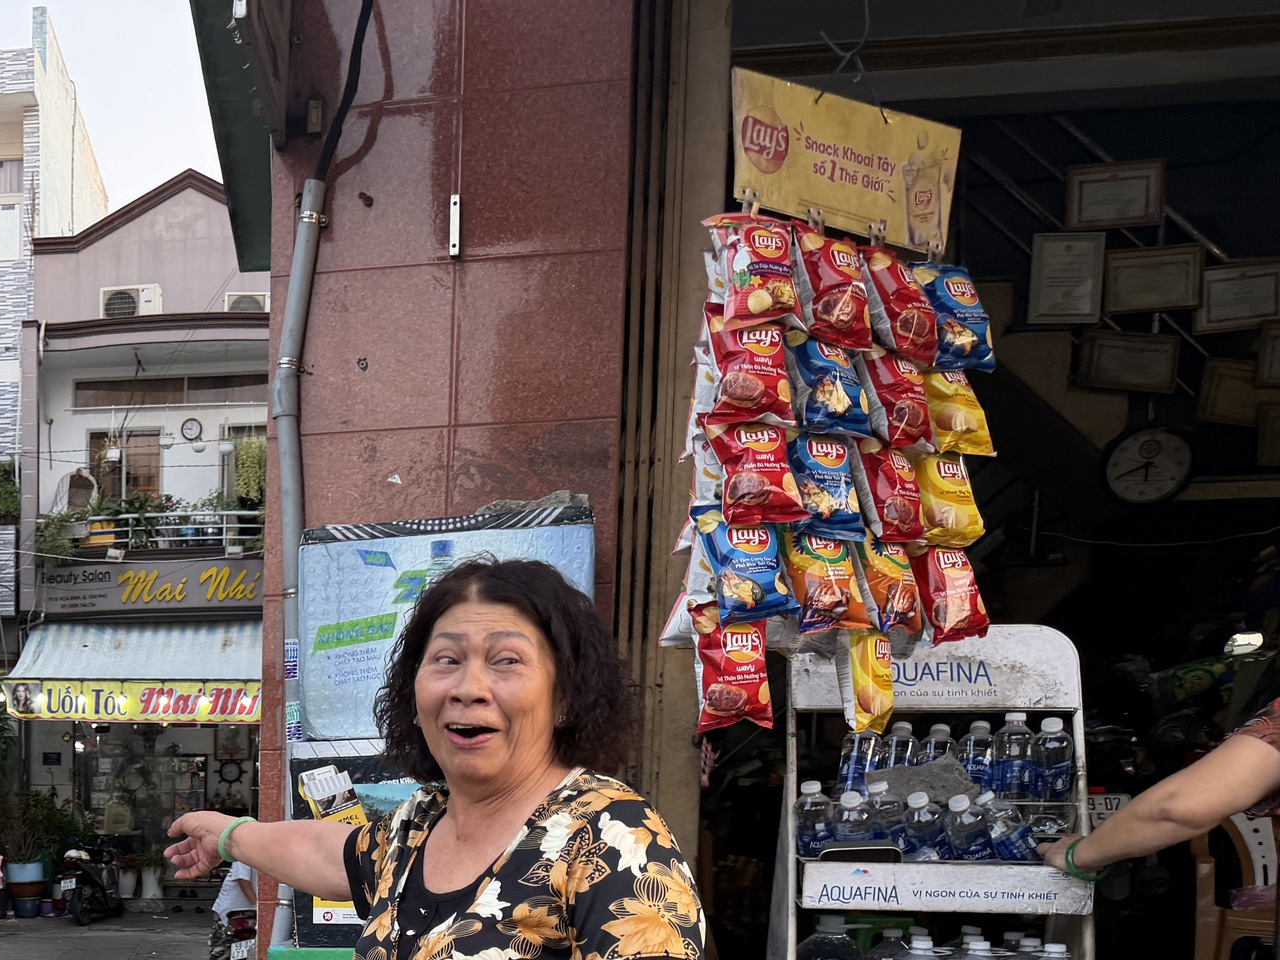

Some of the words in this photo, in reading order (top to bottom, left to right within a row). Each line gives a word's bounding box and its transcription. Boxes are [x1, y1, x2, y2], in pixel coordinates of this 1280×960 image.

[744, 117, 787, 160] Lay's
[805, 136, 839, 158] Snack
[842, 145, 874, 168] Khoai
[877, 156, 896, 176] Tây
[813, 160, 827, 176] số
[827, 159, 837, 182] 1
[839, 167, 858, 185] Thế
[754, 235, 782, 251] Lay's
[834, 249, 859, 269] Lay's
[949, 279, 974, 298] Lay's
[742, 328, 781, 347] Lay's
[741, 428, 777, 443] Lay's
[811, 440, 843, 459] Lay's
[732, 527, 767, 550] Lay's
[938, 551, 966, 569] Lay's
[42, 571, 79, 584] Beauty
[82, 570, 111, 582] Salon
[117, 569, 187, 604] Mai
[199, 566, 260, 602] Nhí
[726, 631, 760, 653] Lay's
[736, 663, 755, 672] wavy
[46, 686, 86, 715] Uốn
[91, 688, 128, 716] Tóc
[139, 687, 205, 716] Mai
[208, 687, 261, 716] Nhí
[909, 688, 929, 697] của
[932, 690, 944, 698] sự
[947, 689, 968, 697] tinh
[971, 688, 998, 697] khiết
[818, 884, 900, 905] AQUAFINA
[912, 890, 923, 898] VỊ
[925, 890, 957, 898] NGON
[959, 888, 980, 900] CỦA
[983, 889, 999, 901] SỰ
[1001, 891, 1025, 900] TINH
[1028, 889, 1059, 901] KHIẾT
